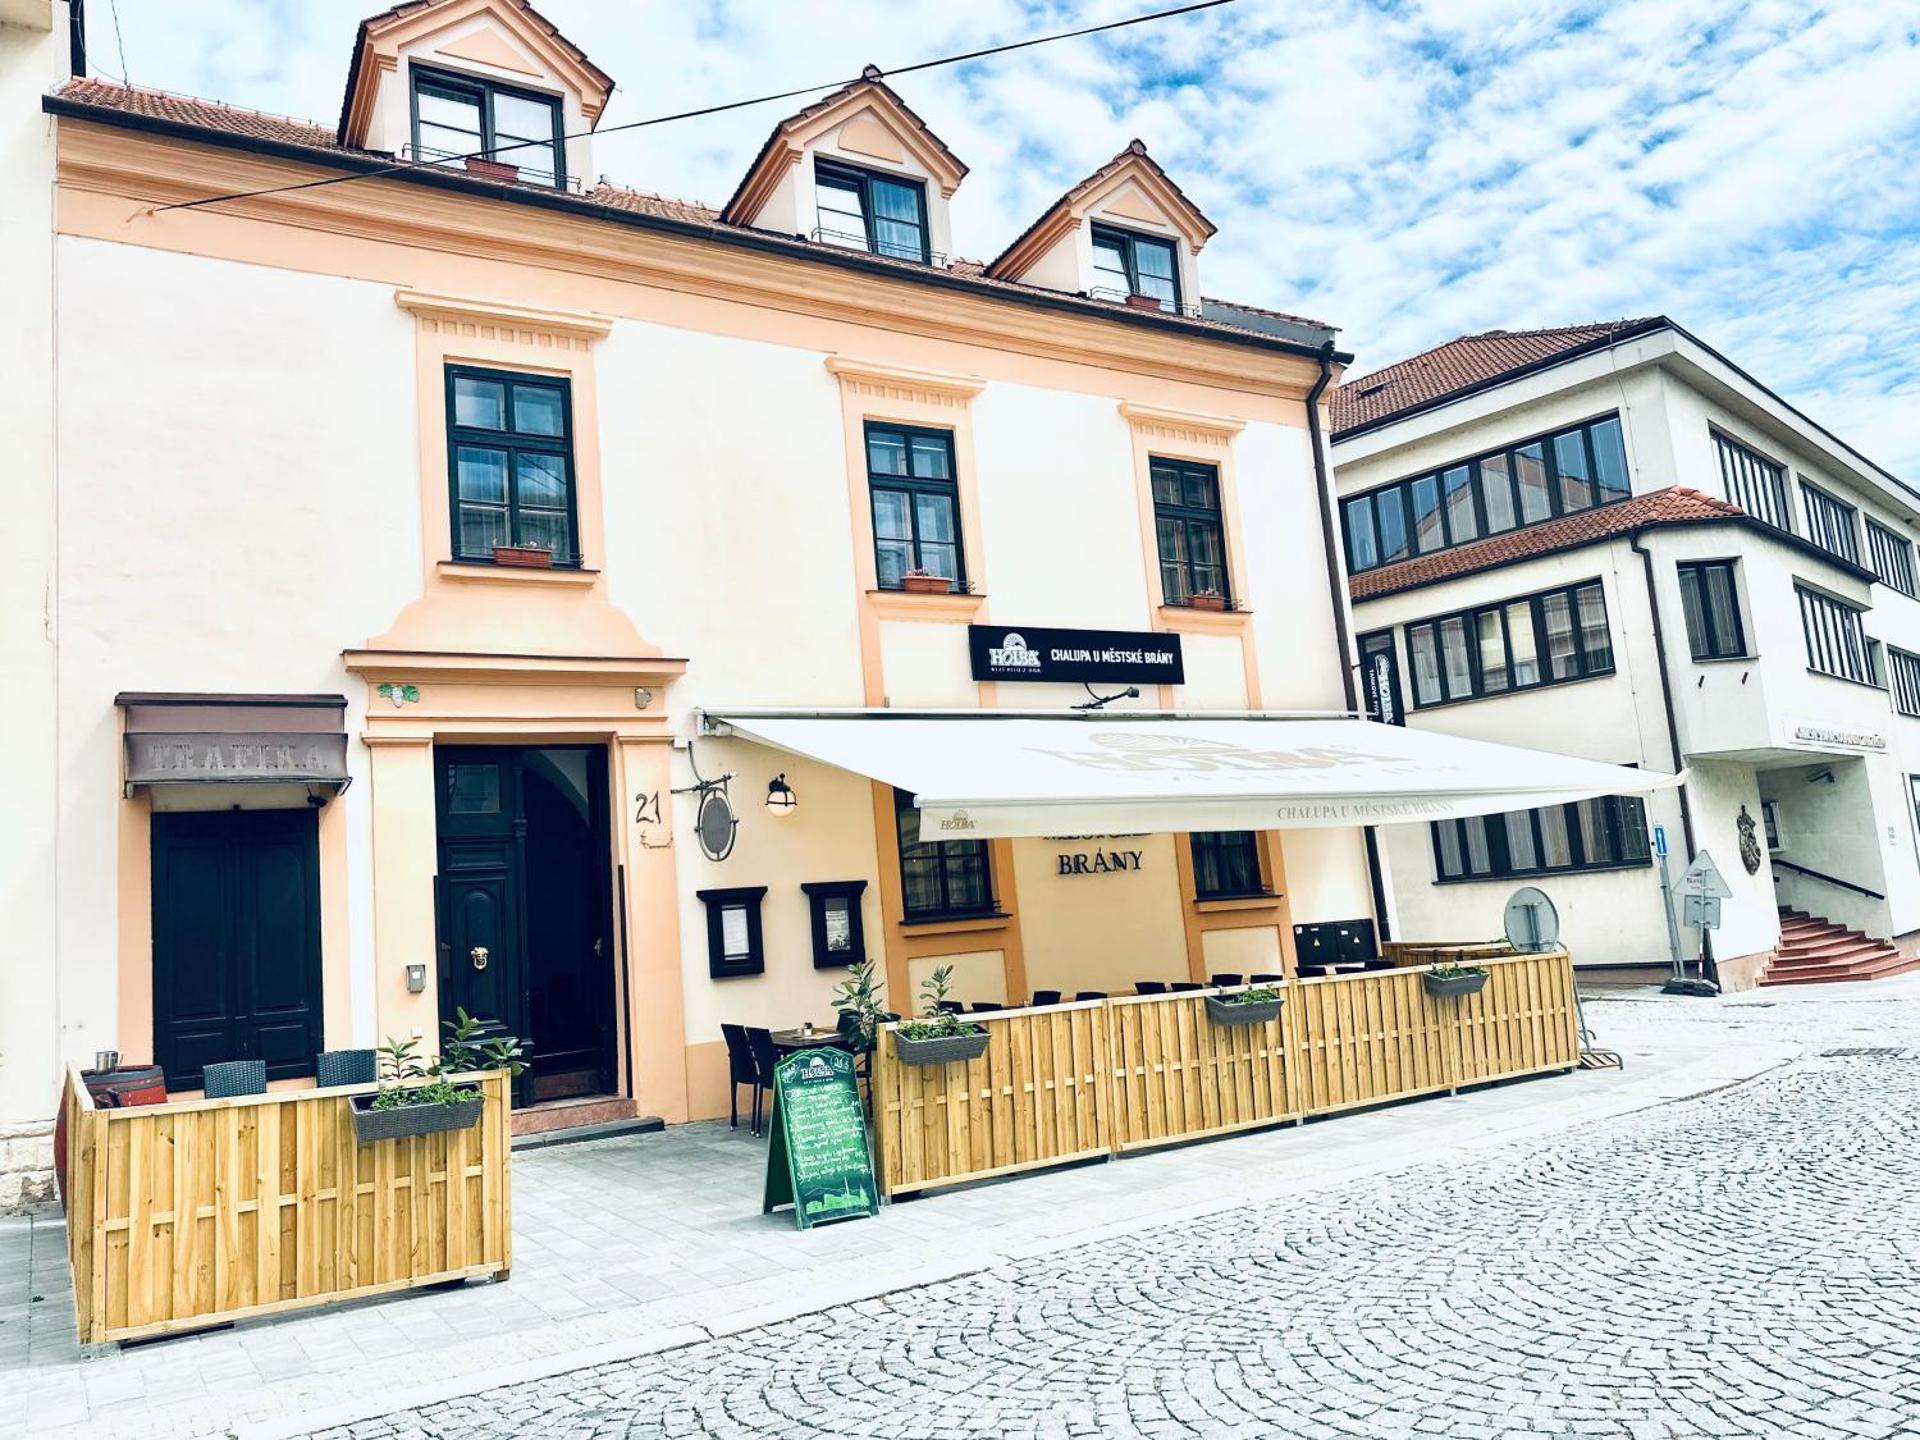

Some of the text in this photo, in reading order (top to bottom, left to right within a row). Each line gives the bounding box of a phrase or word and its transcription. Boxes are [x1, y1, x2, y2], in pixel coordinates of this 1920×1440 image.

[989, 648, 1041, 667] HOLBA
[1051, 648, 1173, 664] CHALUPA U MĚSTSKÉ BRÁNY
[149, 744, 328, 769] TRAFIKA
[635, 790, 662, 824] 21
[1278, 806, 1337, 820] CHALUPA
[1340, 806, 1350, 819] U
[1058, 847, 1142, 875] BRÁNY
